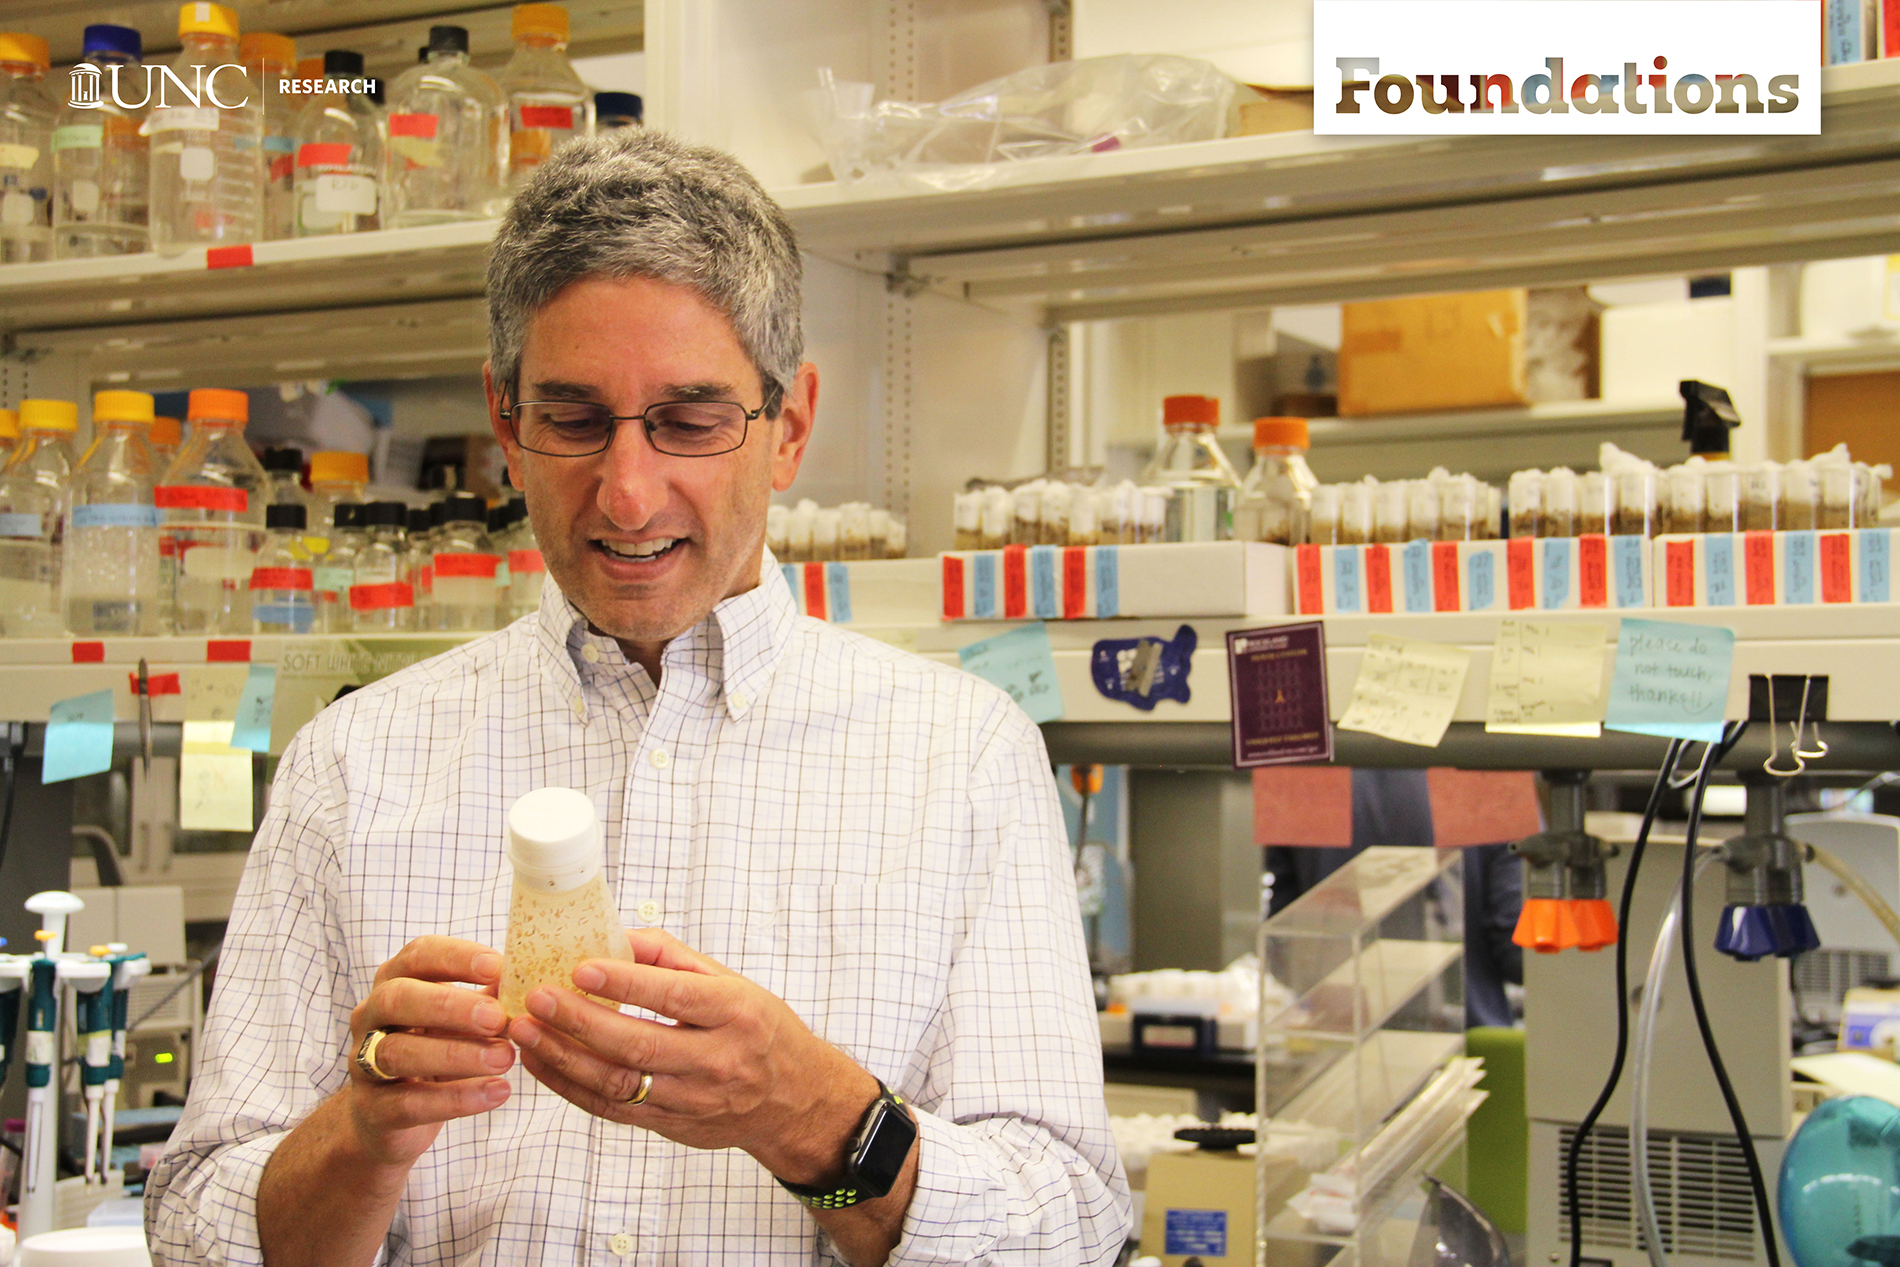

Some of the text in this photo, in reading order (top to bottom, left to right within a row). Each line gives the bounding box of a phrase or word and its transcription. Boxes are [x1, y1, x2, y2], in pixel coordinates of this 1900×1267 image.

[1629, 633, 1708, 657] please do
[283, 653, 321, 673] SOFT
[1635, 663, 1659, 676] not
